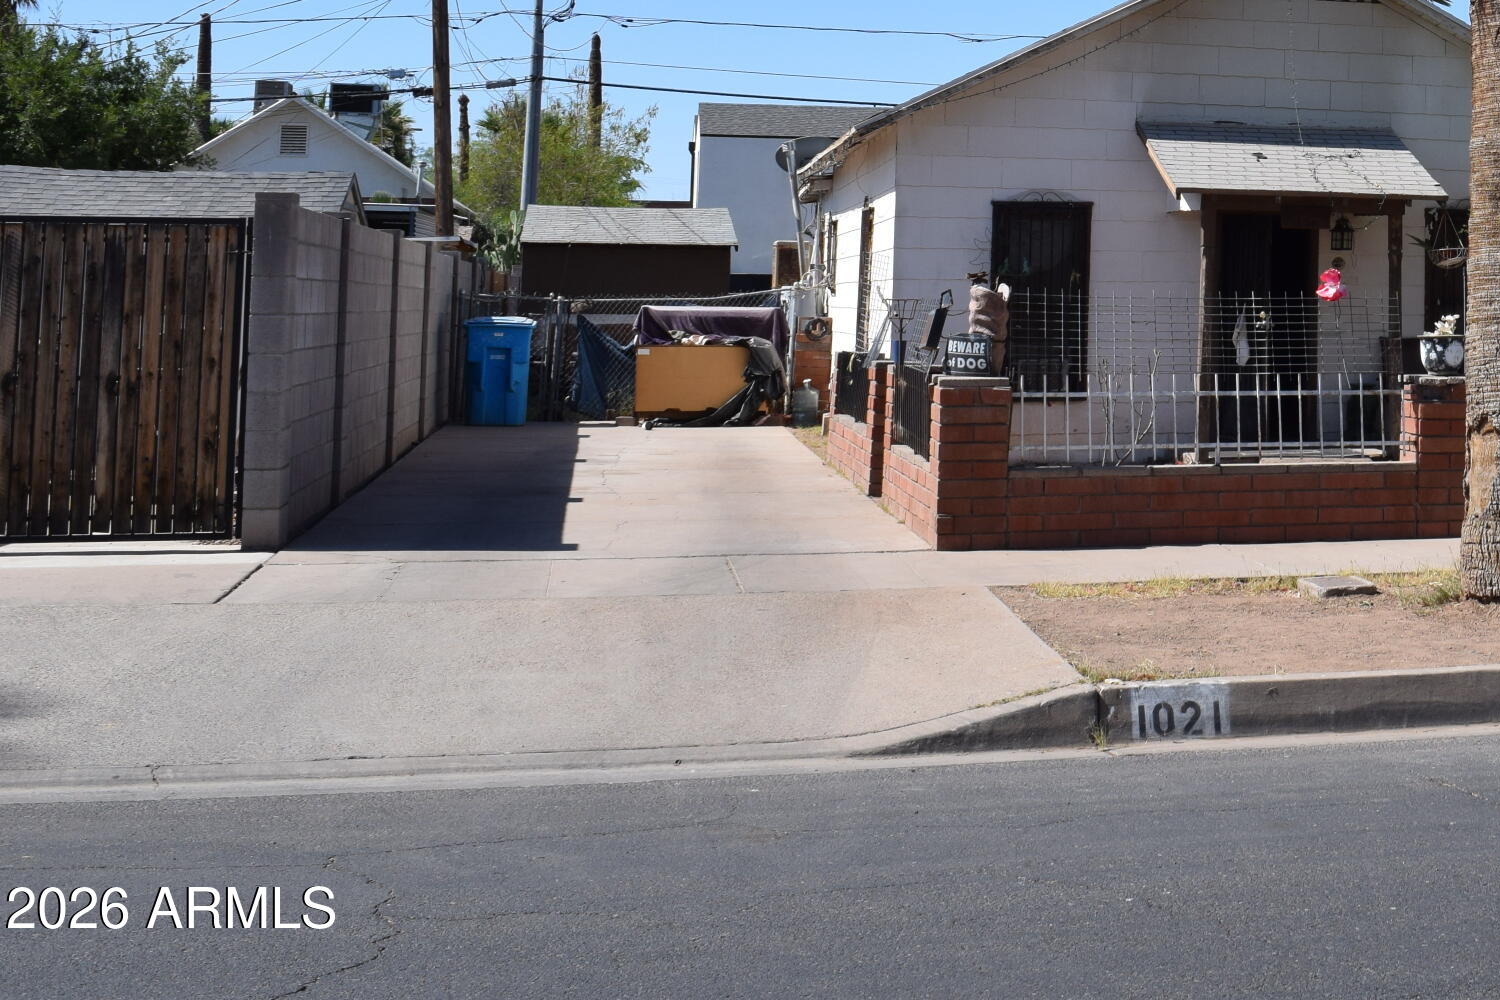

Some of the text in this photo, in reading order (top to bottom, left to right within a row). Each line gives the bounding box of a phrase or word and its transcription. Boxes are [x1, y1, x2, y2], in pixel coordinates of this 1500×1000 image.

[948, 340, 986, 354] BEWARE
[947, 357, 987, 369] of DOG
[1138, 700, 1222, 738] 1021
